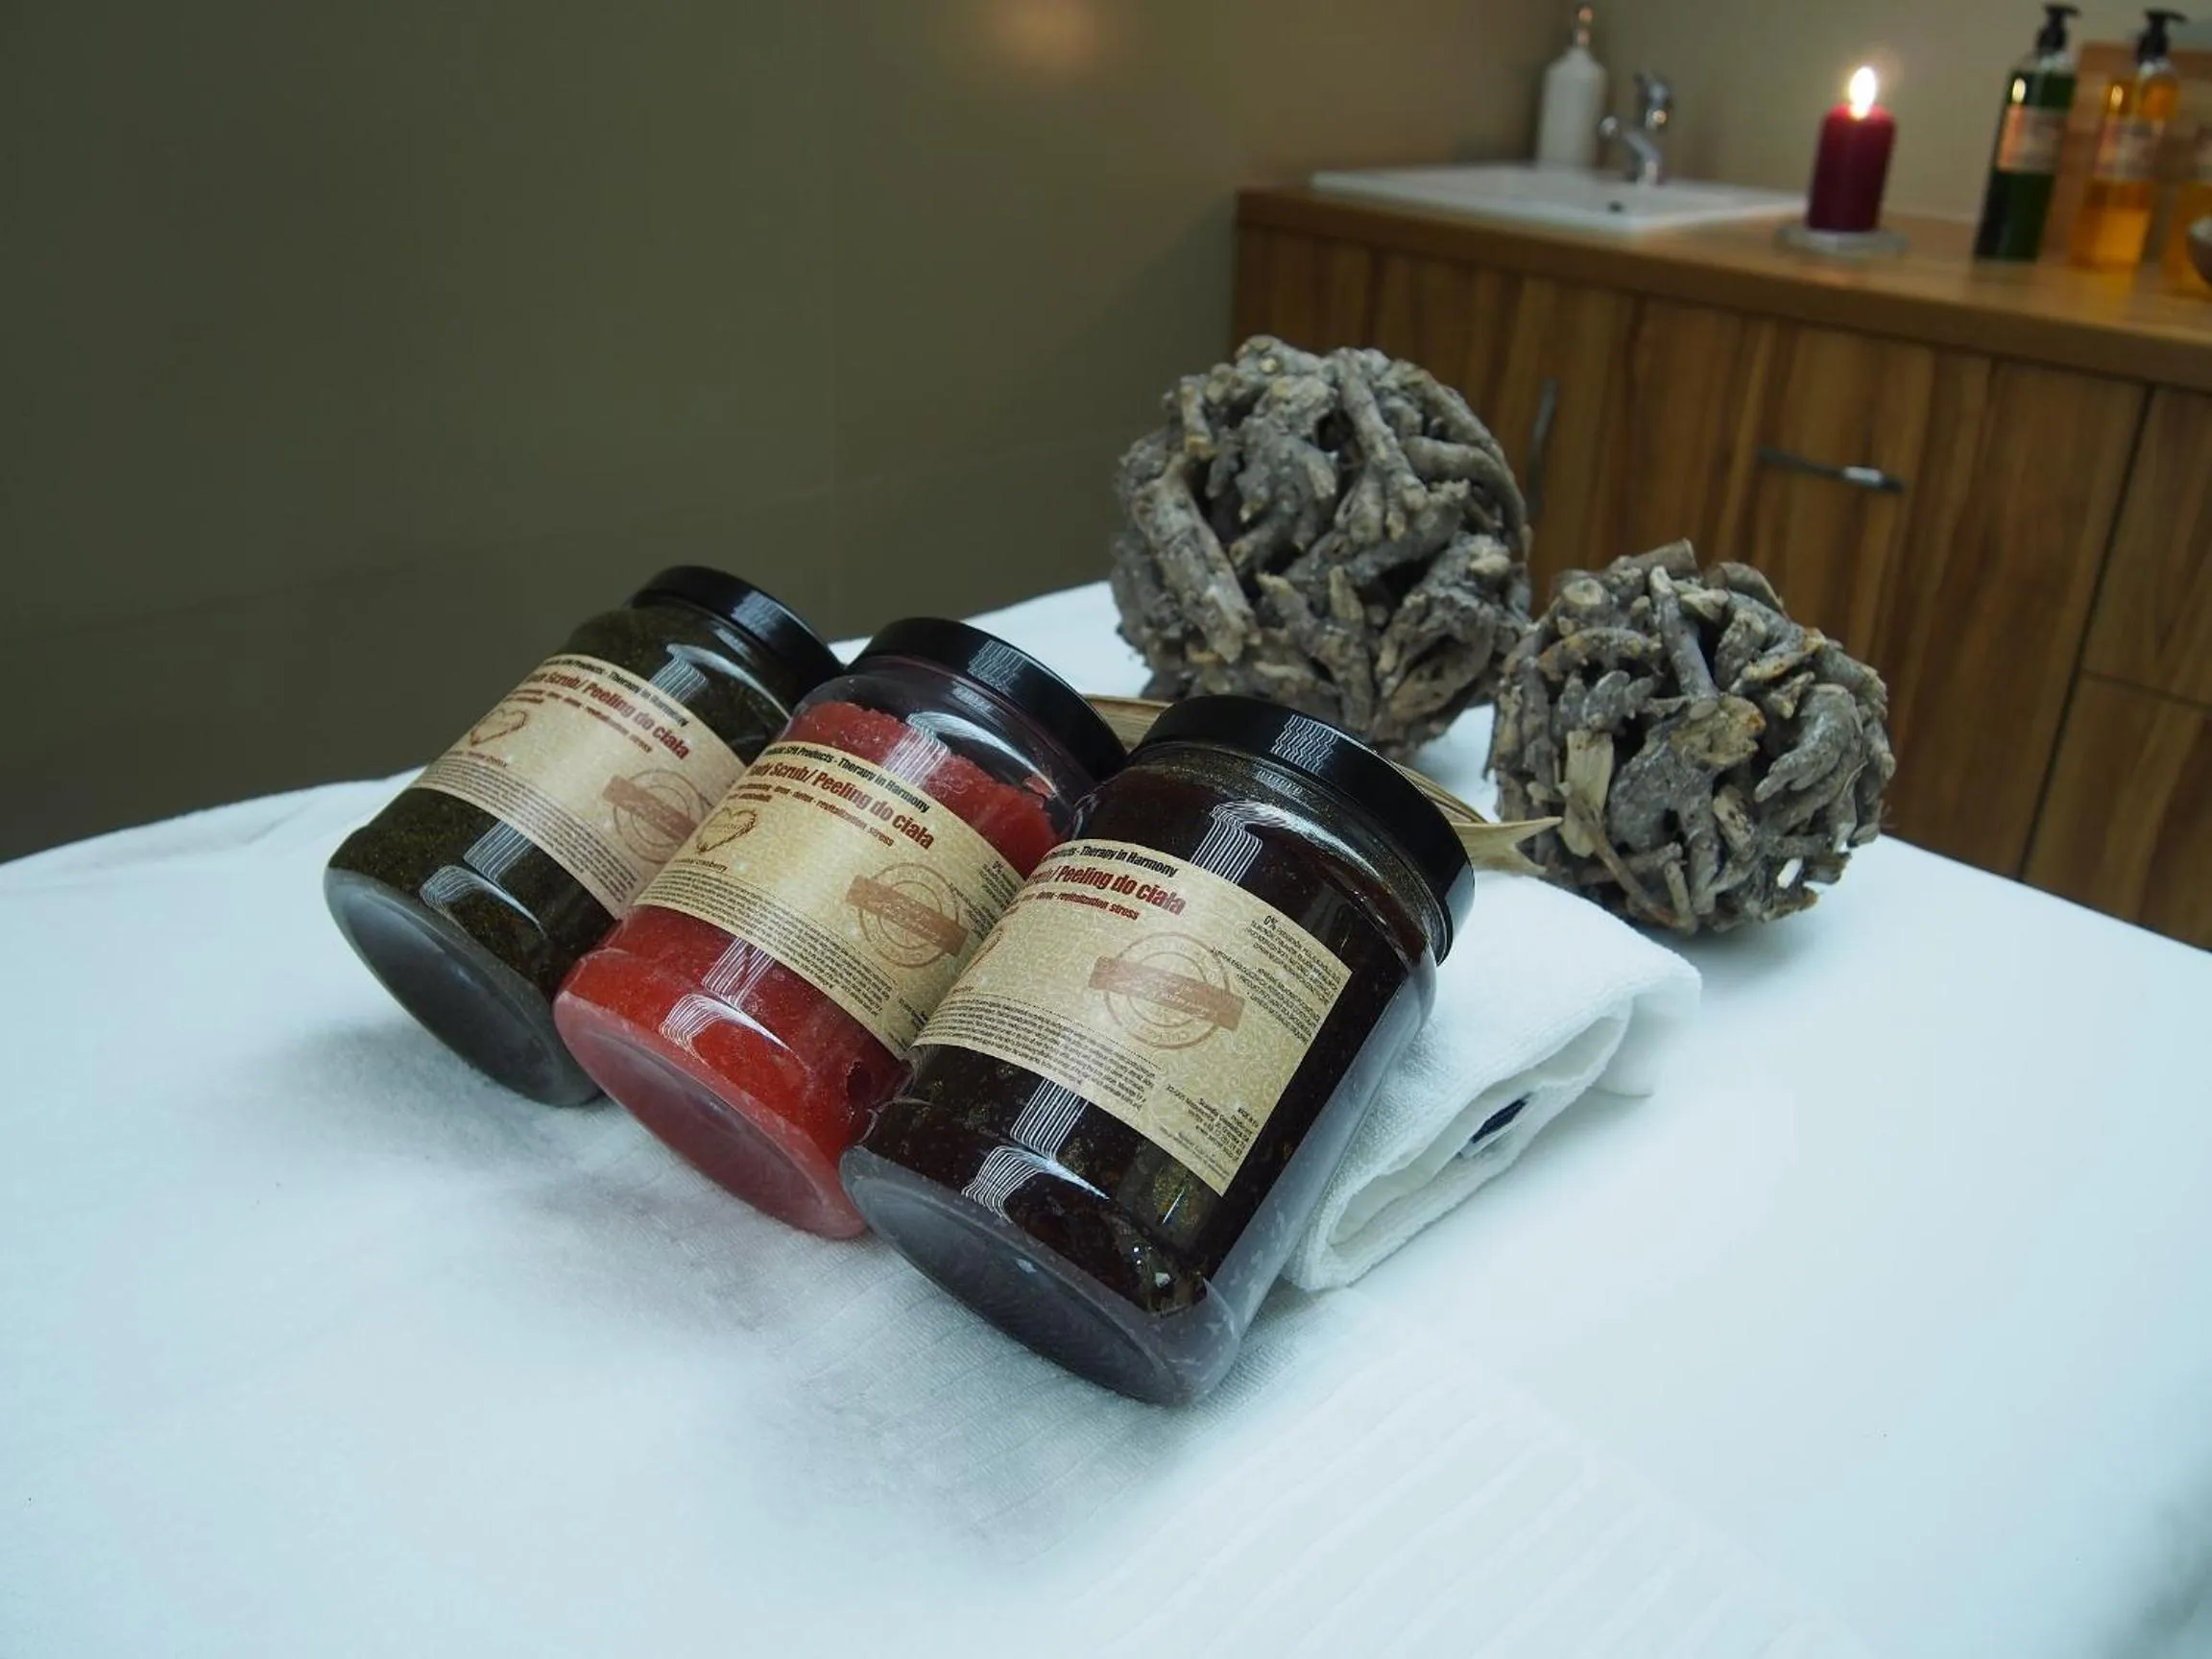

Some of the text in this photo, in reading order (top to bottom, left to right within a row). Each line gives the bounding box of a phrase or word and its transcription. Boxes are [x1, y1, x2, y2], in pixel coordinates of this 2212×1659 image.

[582, 682, 636, 717] Peeling
[633, 710, 655, 731] do
[652, 726, 690, 760] ciała
[797, 748, 834, 763] Products
[838, 757, 876, 783] Therapy
[875, 775, 886, 786] in
[884, 781, 930, 814] Harmony
[811, 770, 871, 810] Peeling
[870, 800, 894, 821] do
[892, 813, 934, 850] ciała
[868, 826, 895, 847] stress
[1079, 845, 1117, 860] Therapy
[1116, 849, 1127, 862] in
[1126, 852, 1178, 878] Harmony
[1055, 865, 1114, 890] Peeling
[1111, 875, 1137, 896] do
[1136, 882, 1187, 916] ciała
[1109, 902, 1141, 922] stress
[1263, 915, 1278, 931] 0%
